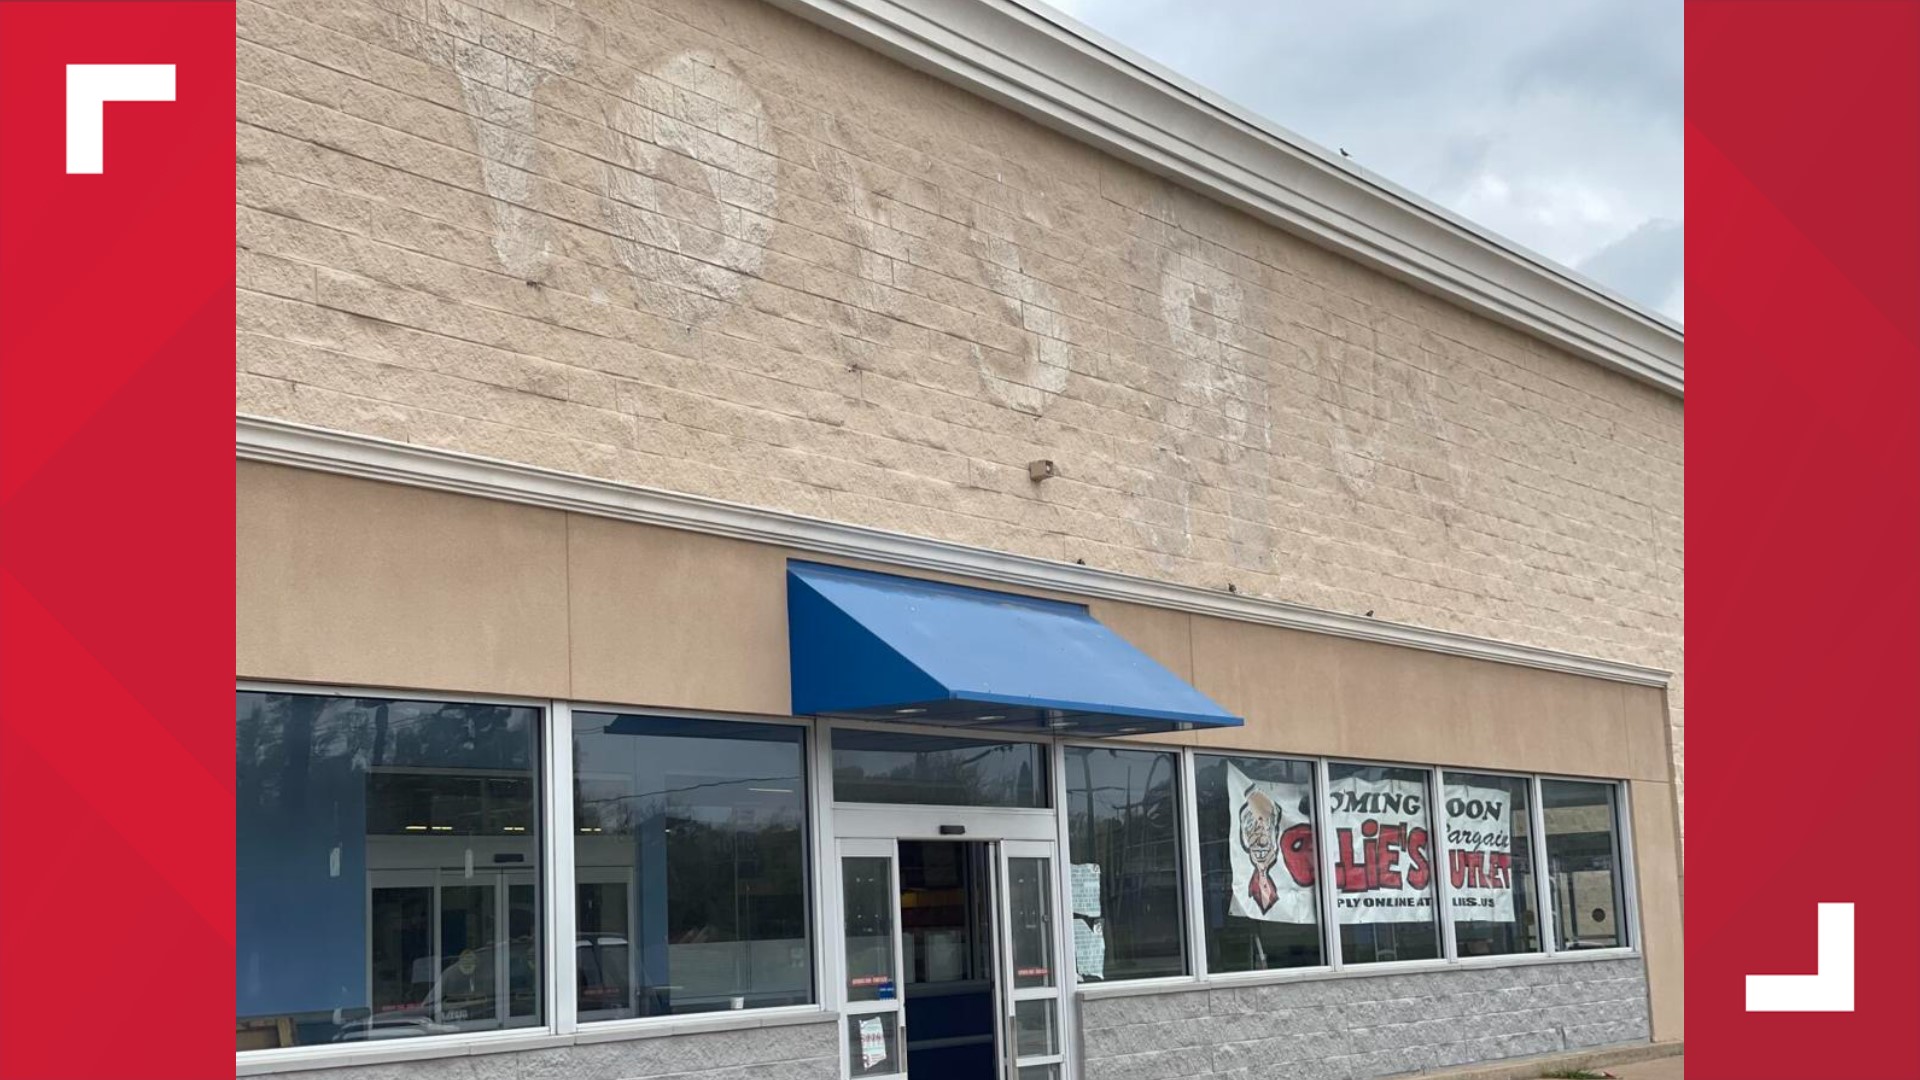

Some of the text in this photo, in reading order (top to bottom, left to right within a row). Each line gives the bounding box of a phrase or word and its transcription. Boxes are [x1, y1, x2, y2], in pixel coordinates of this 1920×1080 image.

[394, 0, 1072, 418] TOYS
[1445, 798, 1502, 821] OON
[1448, 849, 1511, 890] UTLET
[1362, 897, 1415, 908] ONLINE
[1416, 897, 1431, 907] AT
